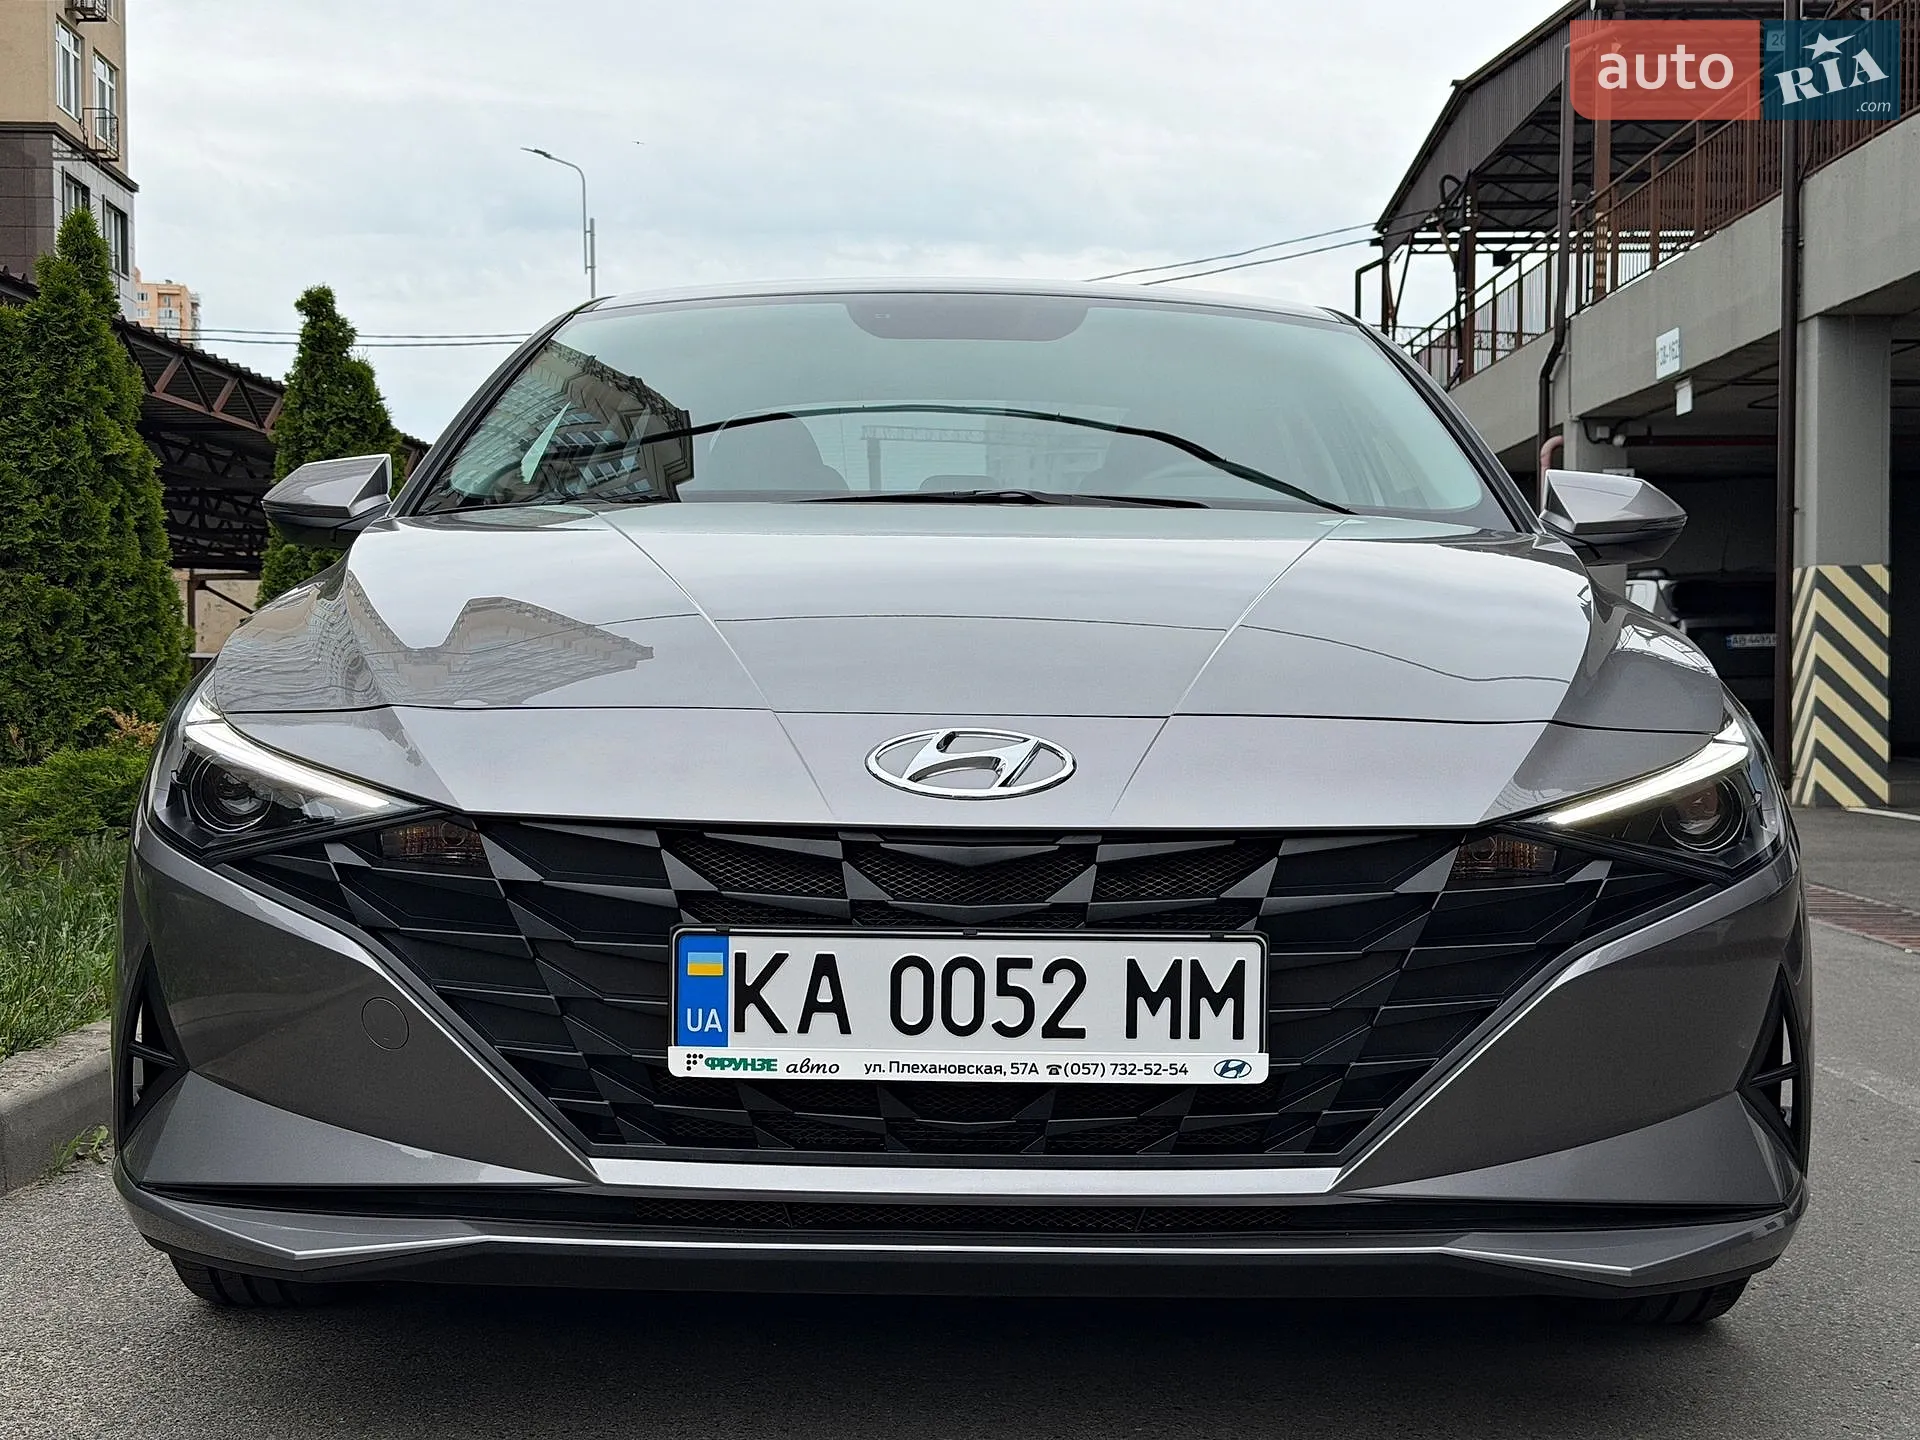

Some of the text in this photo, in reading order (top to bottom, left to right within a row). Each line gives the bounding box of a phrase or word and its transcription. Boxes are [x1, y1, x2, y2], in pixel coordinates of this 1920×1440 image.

[734, 952, 1246, 1040] KA 0052 MM
[687, 1008, 722, 1032] UA
[704, 1057, 840, 1075] ФРУНЗЕ авто
[864, 1060, 1189, 1077] ул. Плехановская, 57А (057) 732-52-54
